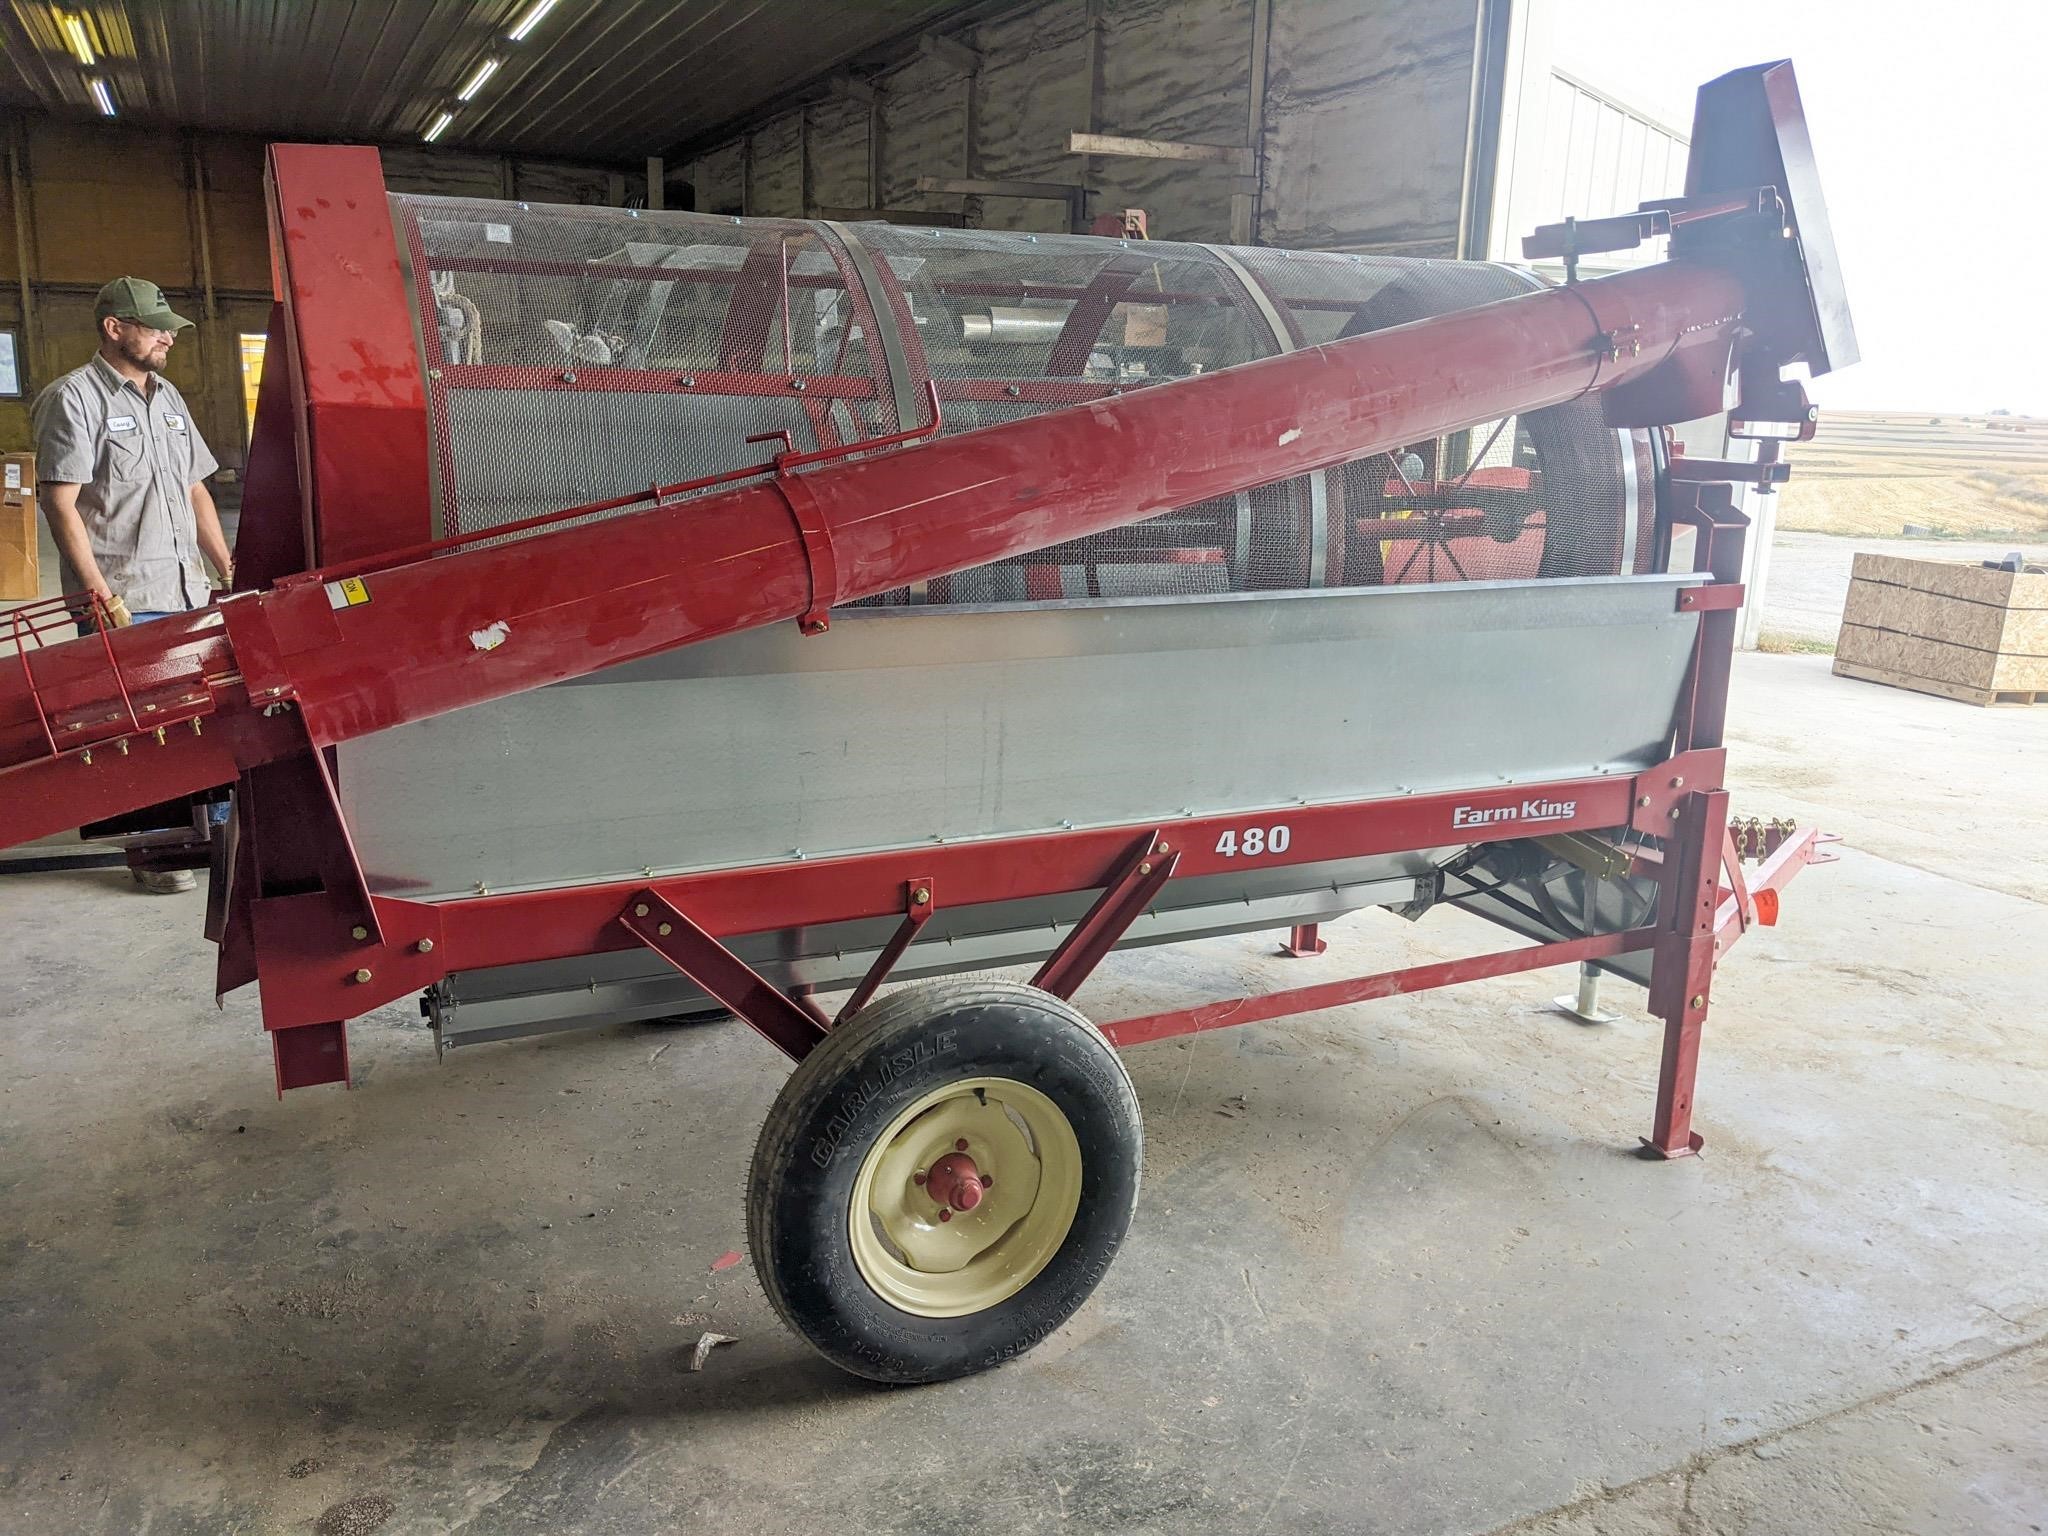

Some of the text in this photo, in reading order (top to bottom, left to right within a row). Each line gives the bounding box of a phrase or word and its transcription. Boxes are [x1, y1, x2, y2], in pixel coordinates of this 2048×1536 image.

[1453, 799, 1577, 825] Farm King
[1215, 825, 1290, 857] 480
[811, 1029, 958, 1168] CARLISLE
[1084, 1241, 1117, 1286] FARM
